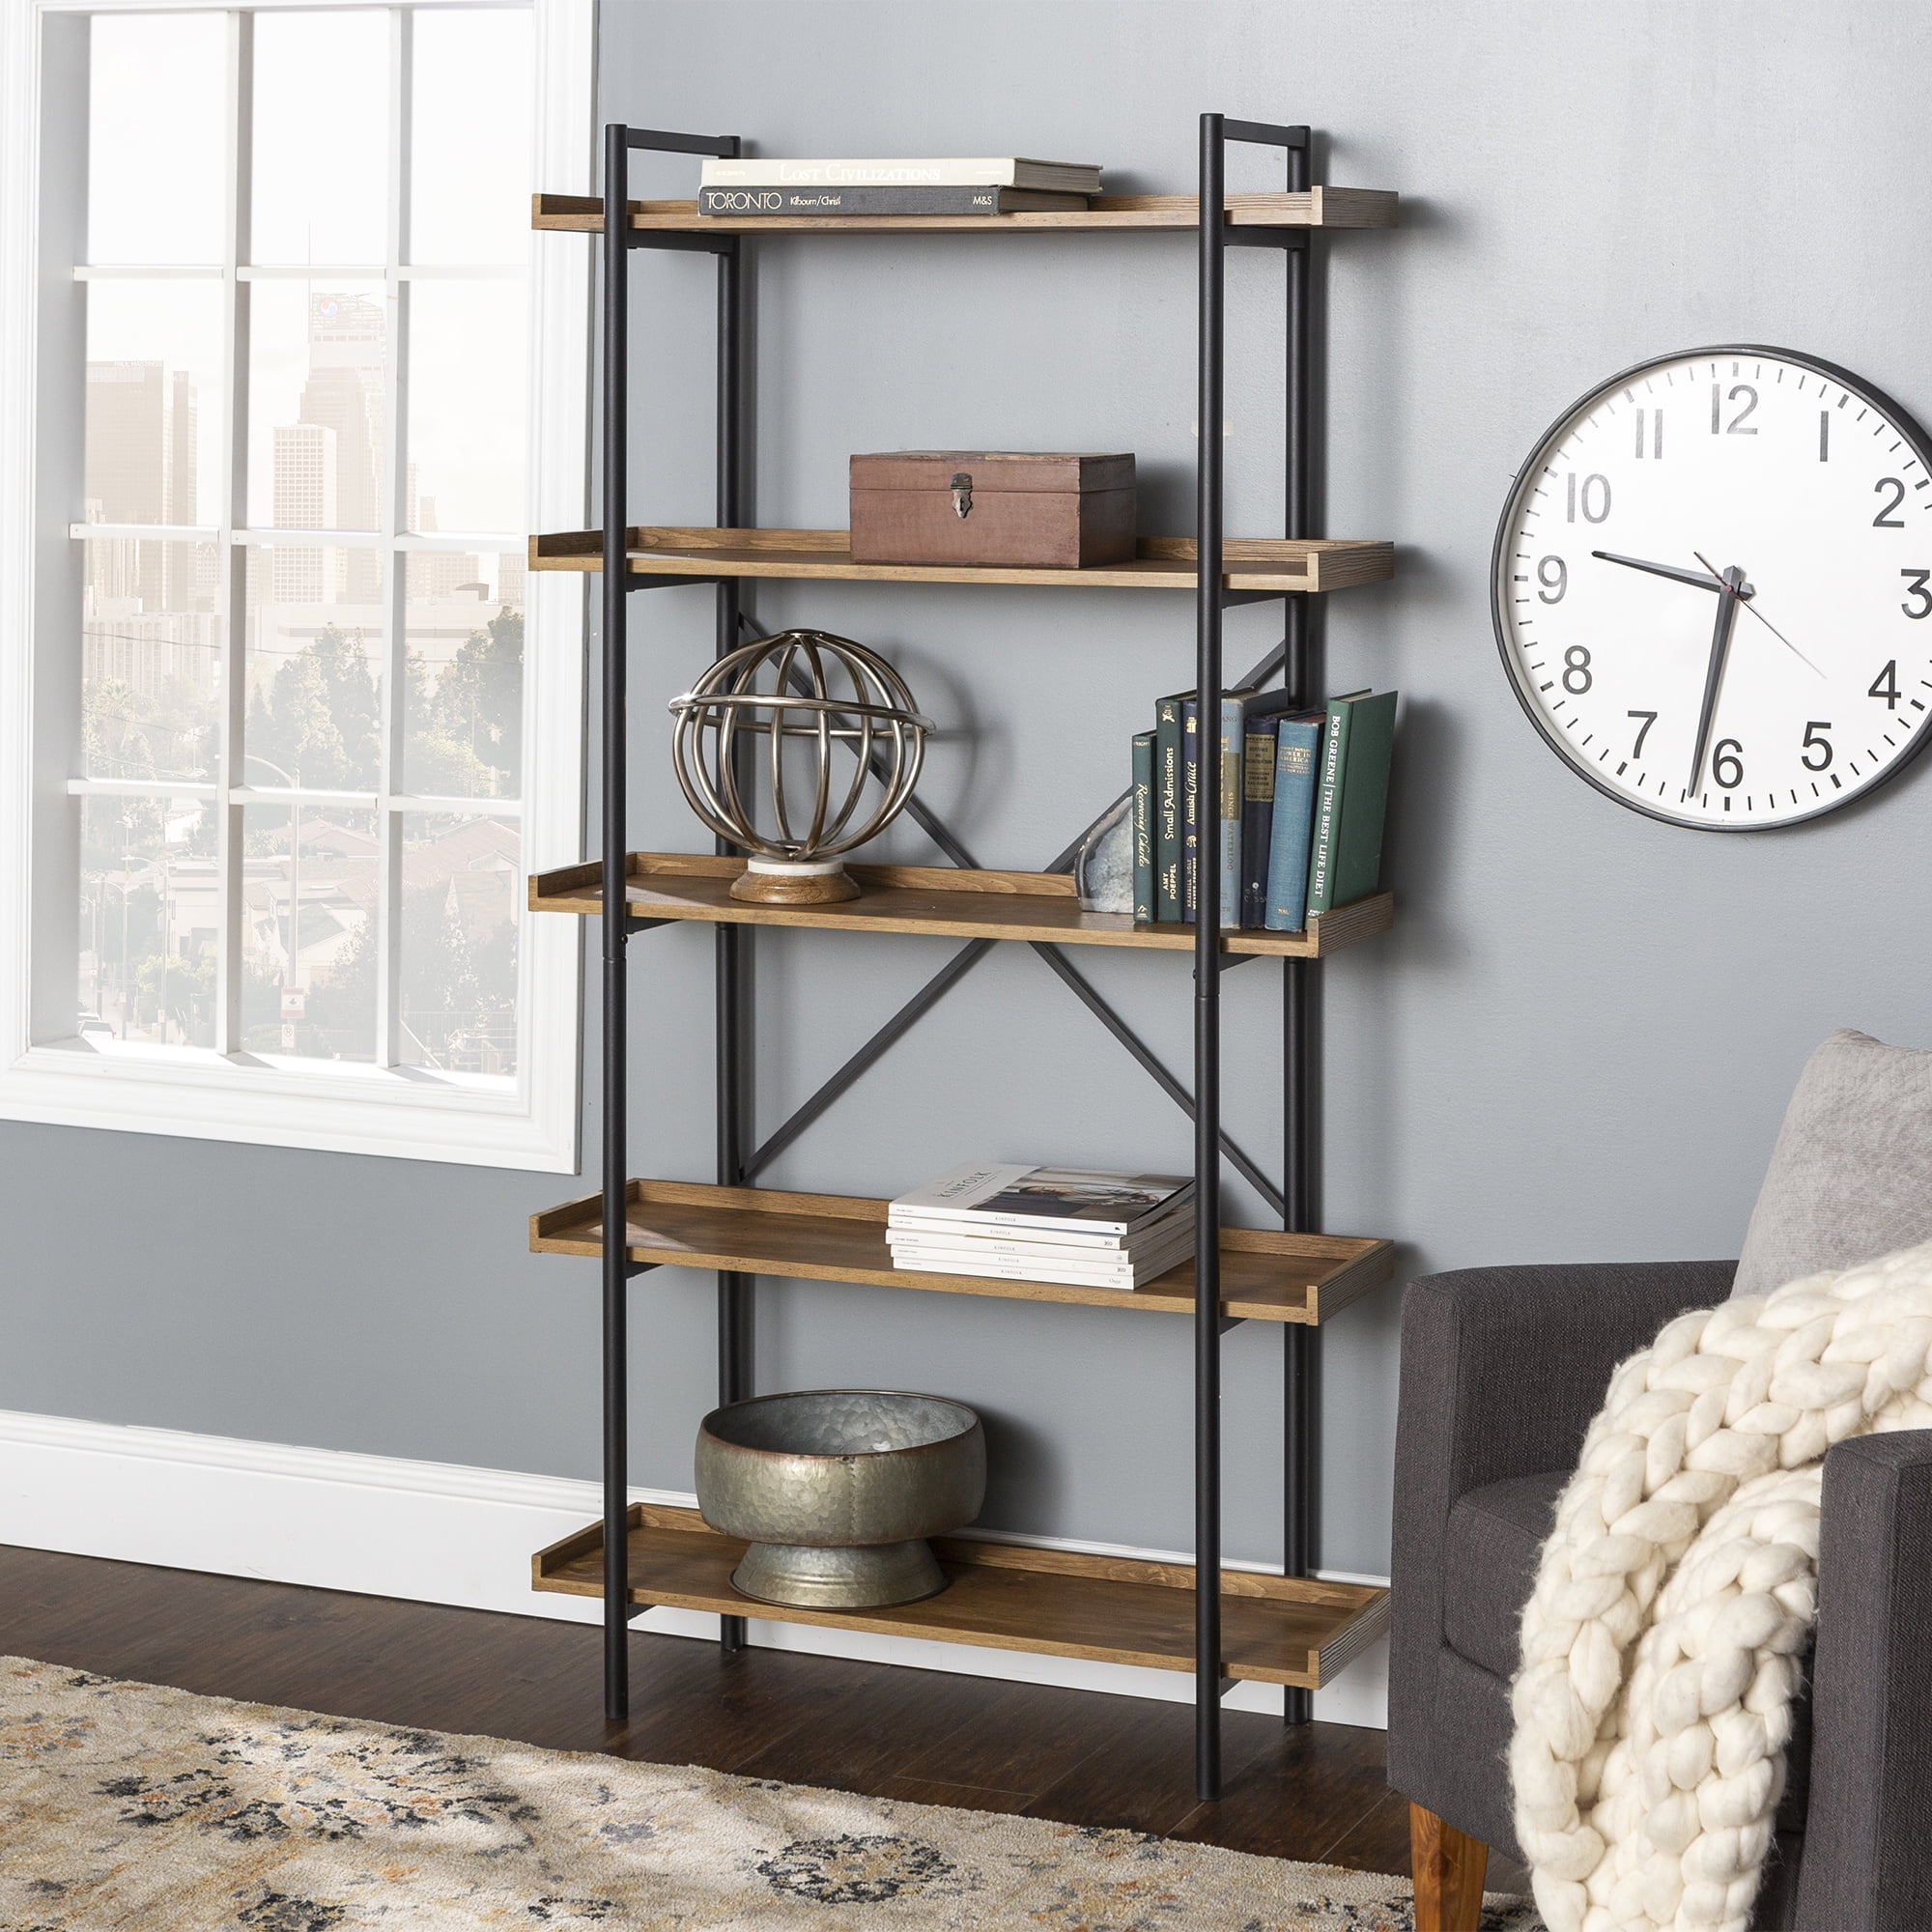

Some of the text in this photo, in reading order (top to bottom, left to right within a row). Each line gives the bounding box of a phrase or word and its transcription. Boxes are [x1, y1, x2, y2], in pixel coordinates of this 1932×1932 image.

[706, 192, 781, 210] TORONTO
[973, 195, 993, 206] M&S
[1635, 409, 1662, 459] 11
[1712, 384, 1758, 435] 12
[1820, 411, 1829, 462] 1
[1567, 472, 1611, 524] 10
[1872, 477, 1905, 528] 2
[1537, 555, 1567, 605] 9
[1901, 569, 1932, 619] 3
[1562, 645, 1593, 695] 8
[1868, 660, 1901, 710] 4
[1330, 716, 1341, 737] BOB
[1627, 710, 1658, 759] 7
[1801, 722, 1833, 772] 5
[1326, 740, 1339, 782] GREENE
[1713, 739, 1744, 788] 6
[1163, 747, 1176, 839] Small Admissions
[1184, 761, 1197, 825] Amish Grace
[1323, 789, 1333, 812] THE
[1134, 783, 1151, 867] Recovering Charles
[1227, 791, 1236, 871] SINCE WATERLOO
[1320, 815, 1331, 842] BEST
[1317, 844, 1328, 868] LIFE
[1315, 870, 1325, 897] DIET
[936, 1171, 992, 1198] KINFOLK
